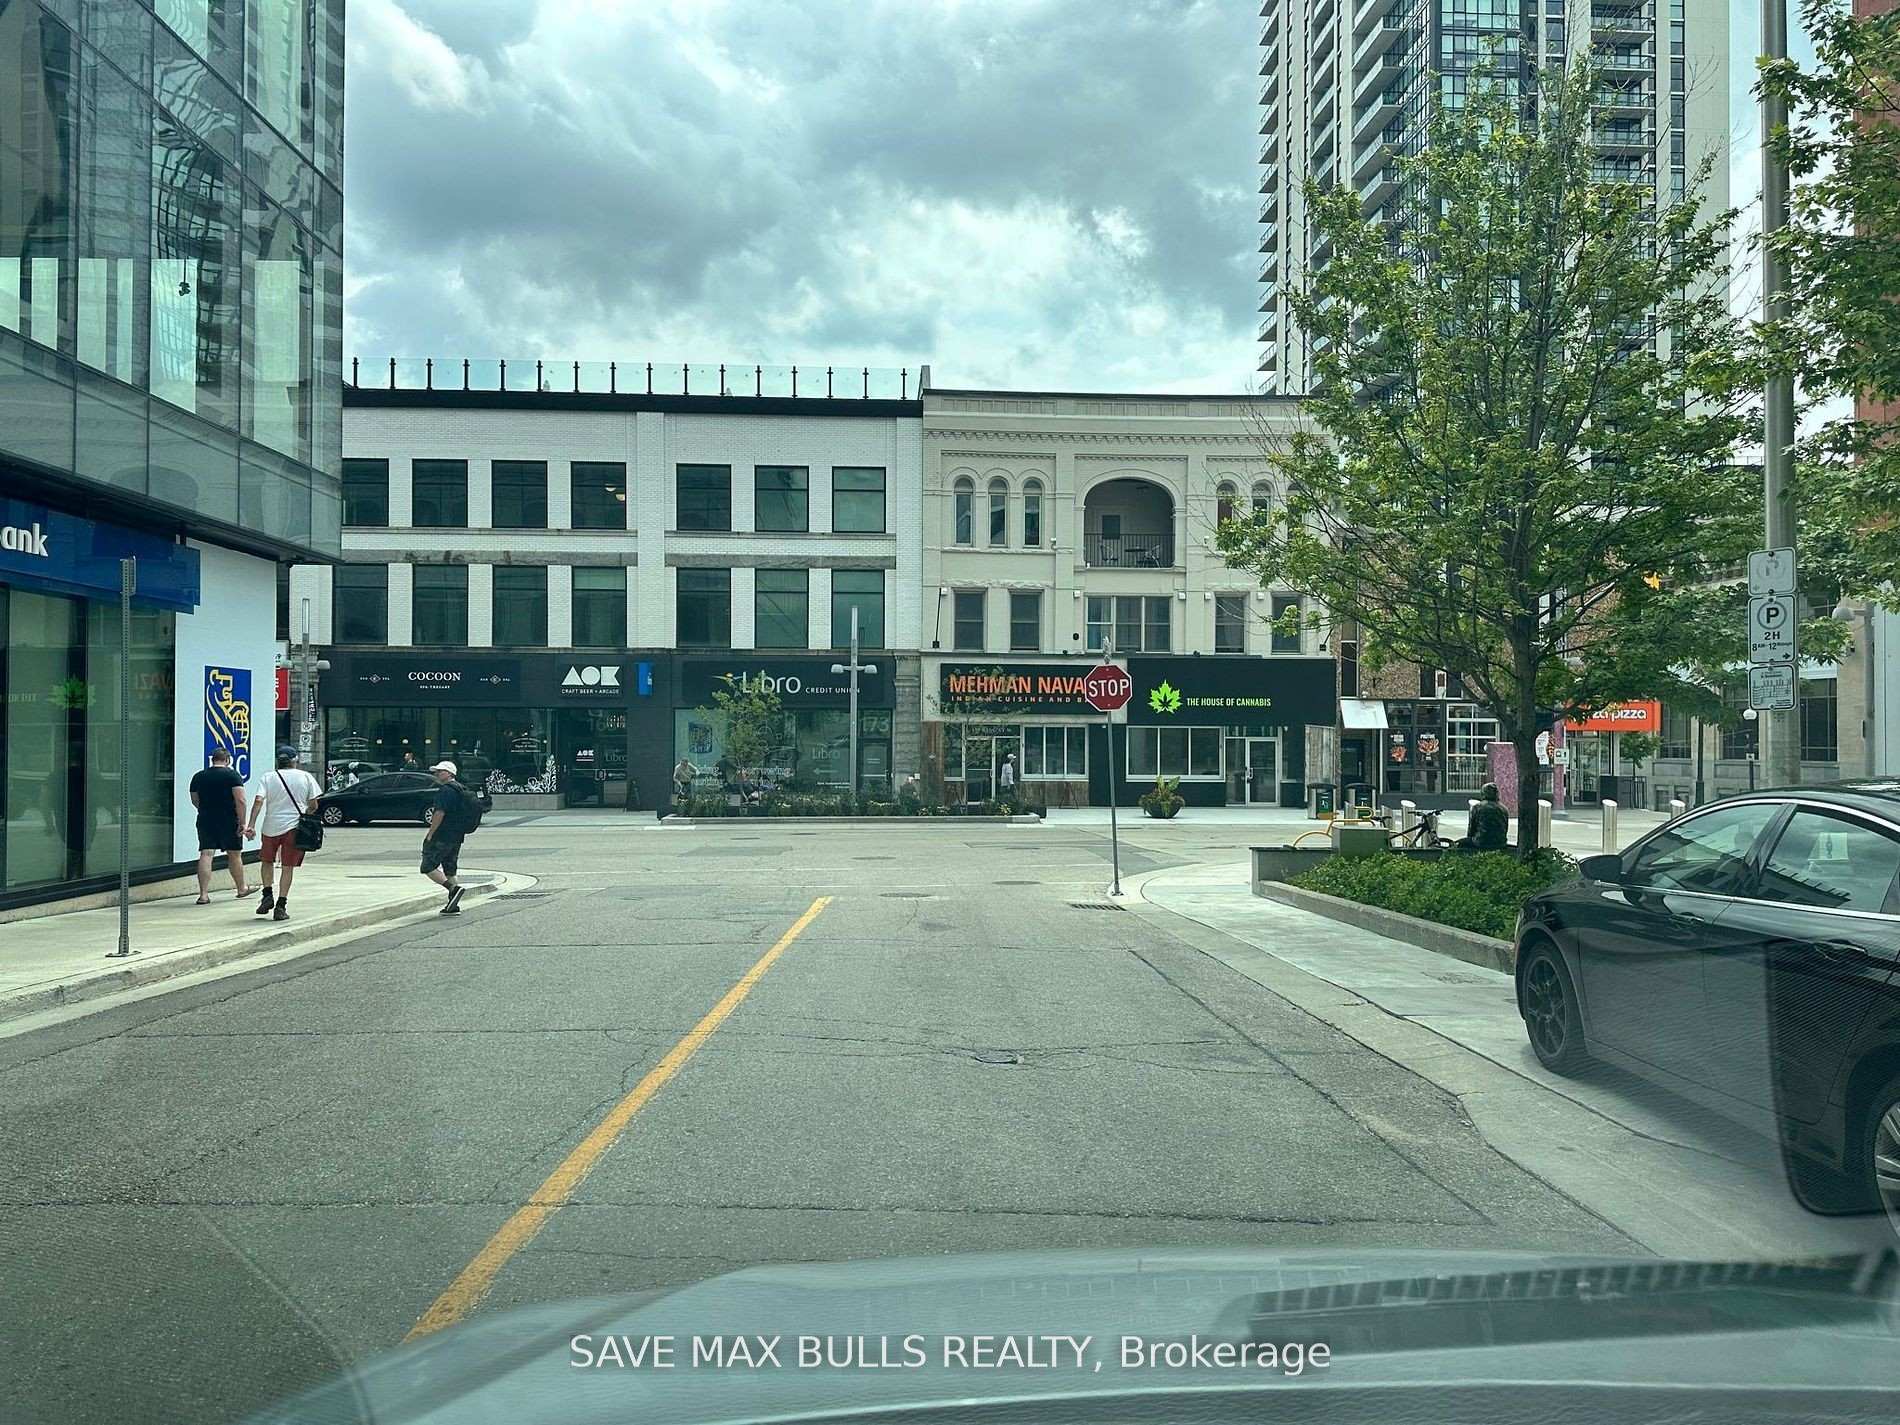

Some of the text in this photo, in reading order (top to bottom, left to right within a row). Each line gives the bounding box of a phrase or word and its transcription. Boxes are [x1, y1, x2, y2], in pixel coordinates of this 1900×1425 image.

[0, 523, 48, 557] ank
[1766, 607, 1779, 623] P
[408, 672, 461, 681] COCOON
[742, 669, 801, 694] Lbro
[950, 676, 1086, 694] MEHMAN NAVA
[1088, 679, 1129, 698] STOP
[1187, 697, 1272, 707] THE HOUSE OF CANNABIS
[1610, 708, 1647, 722] pizza
